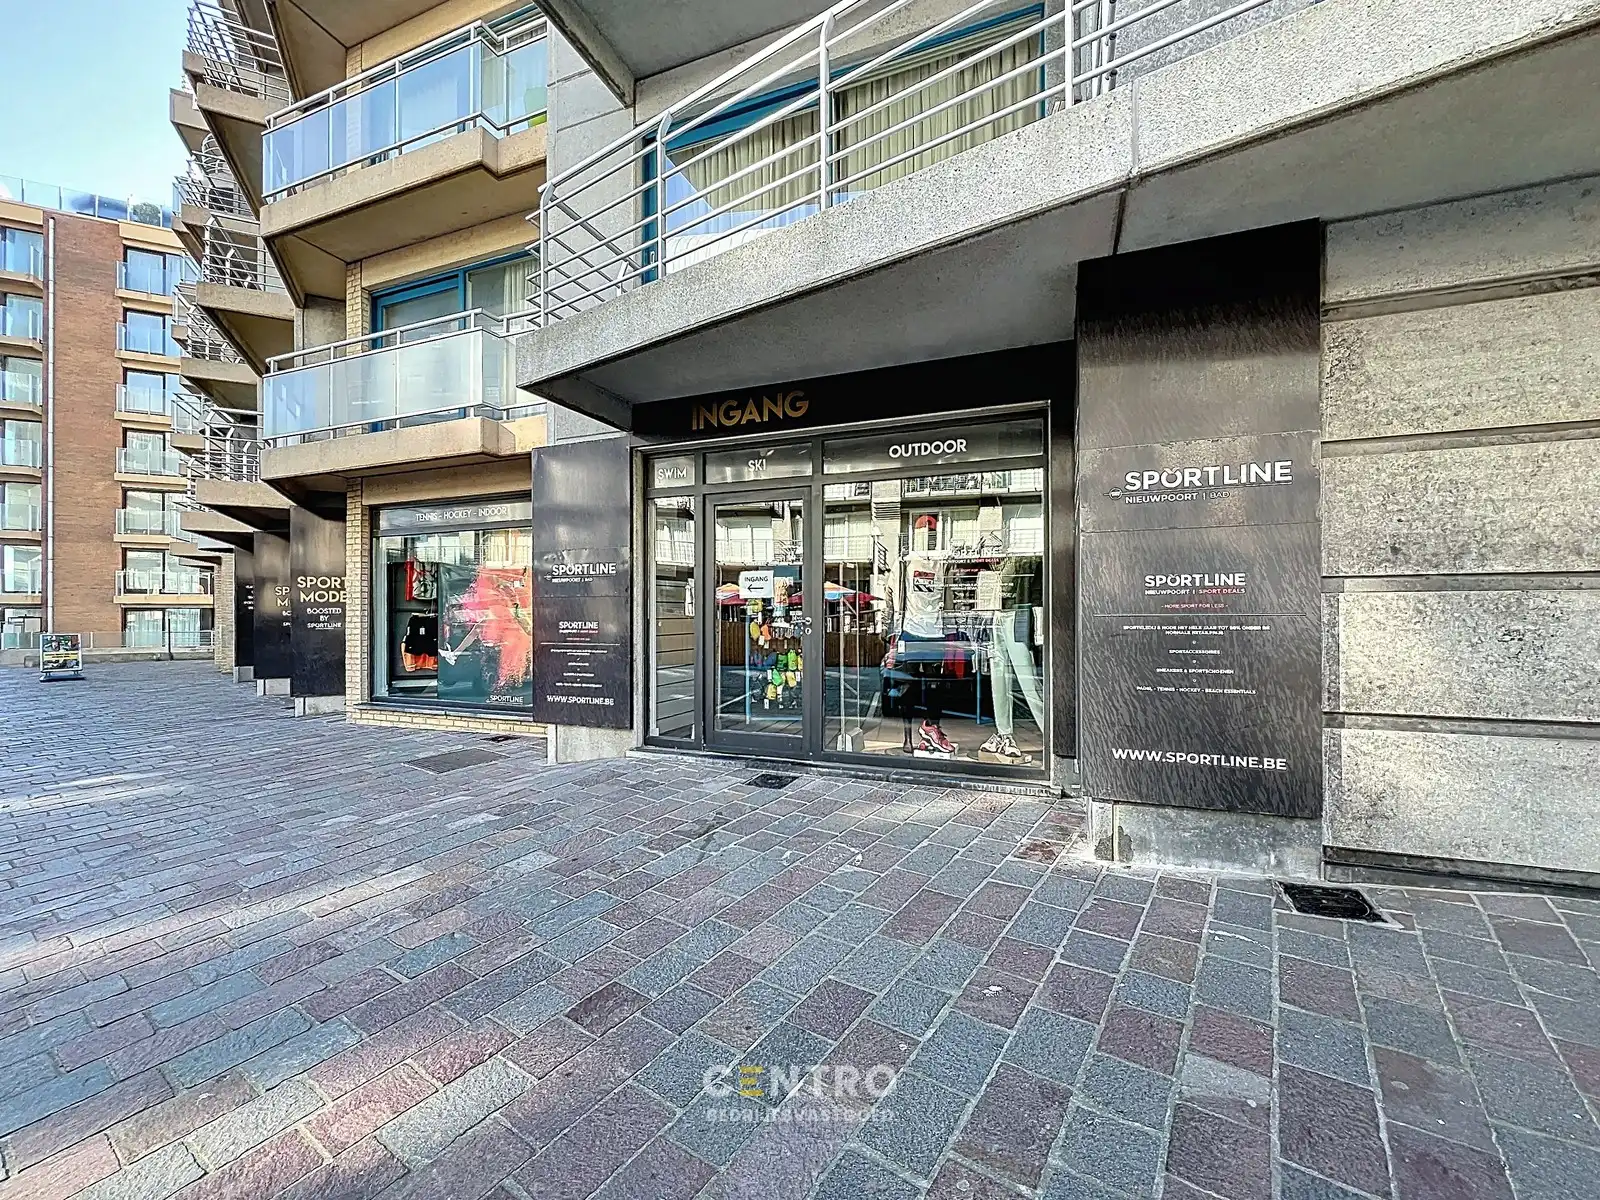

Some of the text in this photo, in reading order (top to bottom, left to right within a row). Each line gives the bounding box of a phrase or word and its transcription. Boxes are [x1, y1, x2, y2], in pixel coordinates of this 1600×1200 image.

[692, 390, 809, 431] INGANG
[889, 438, 967, 459] OUTDOOR
[748, 459, 767, 471] SKI
[658, 467, 687, 479] SWIM
[1125, 460, 1294, 491] SPORTLINE
[1125, 492, 1199, 504] NIEUWPOORT
[1209, 491, 1231, 499] BAD
[416, 512, 438, 521] TENNIS
[443, 509, 472, 520] HOCKEY
[478, 507, 507, 517] INDOOR
[552, 563, 617, 575] SPORTLINE
[1144, 573, 1246, 587] SPORTLINE
[559, 621, 599, 629] SPORTLINE
[490, 695, 524, 703] SPORTLINE
[547, 694, 614, 706] WWW.SPORTLINE.BE
[1112, 748, 1287, 771] WWW.SPORTLINE.BE
